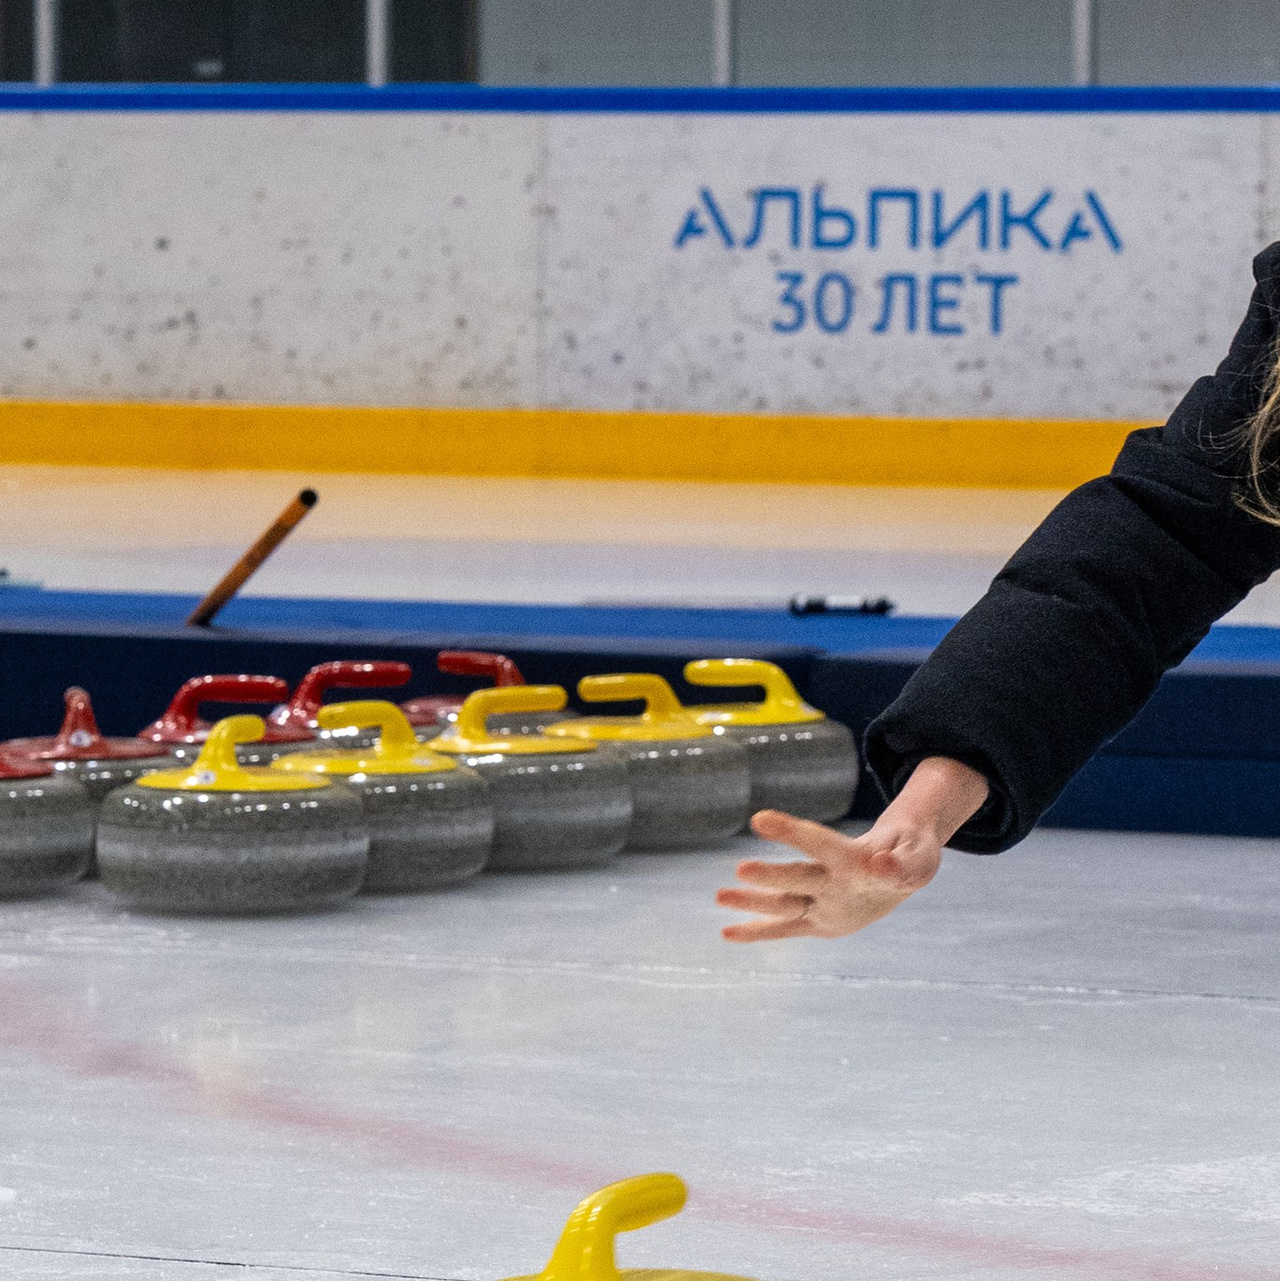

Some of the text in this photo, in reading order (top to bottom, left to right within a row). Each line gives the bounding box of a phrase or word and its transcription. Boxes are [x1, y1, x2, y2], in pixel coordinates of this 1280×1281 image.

[674, 187, 1123, 253] АЛЬПИКА
[772, 271, 1020, 336] 30 ЛЕТ
